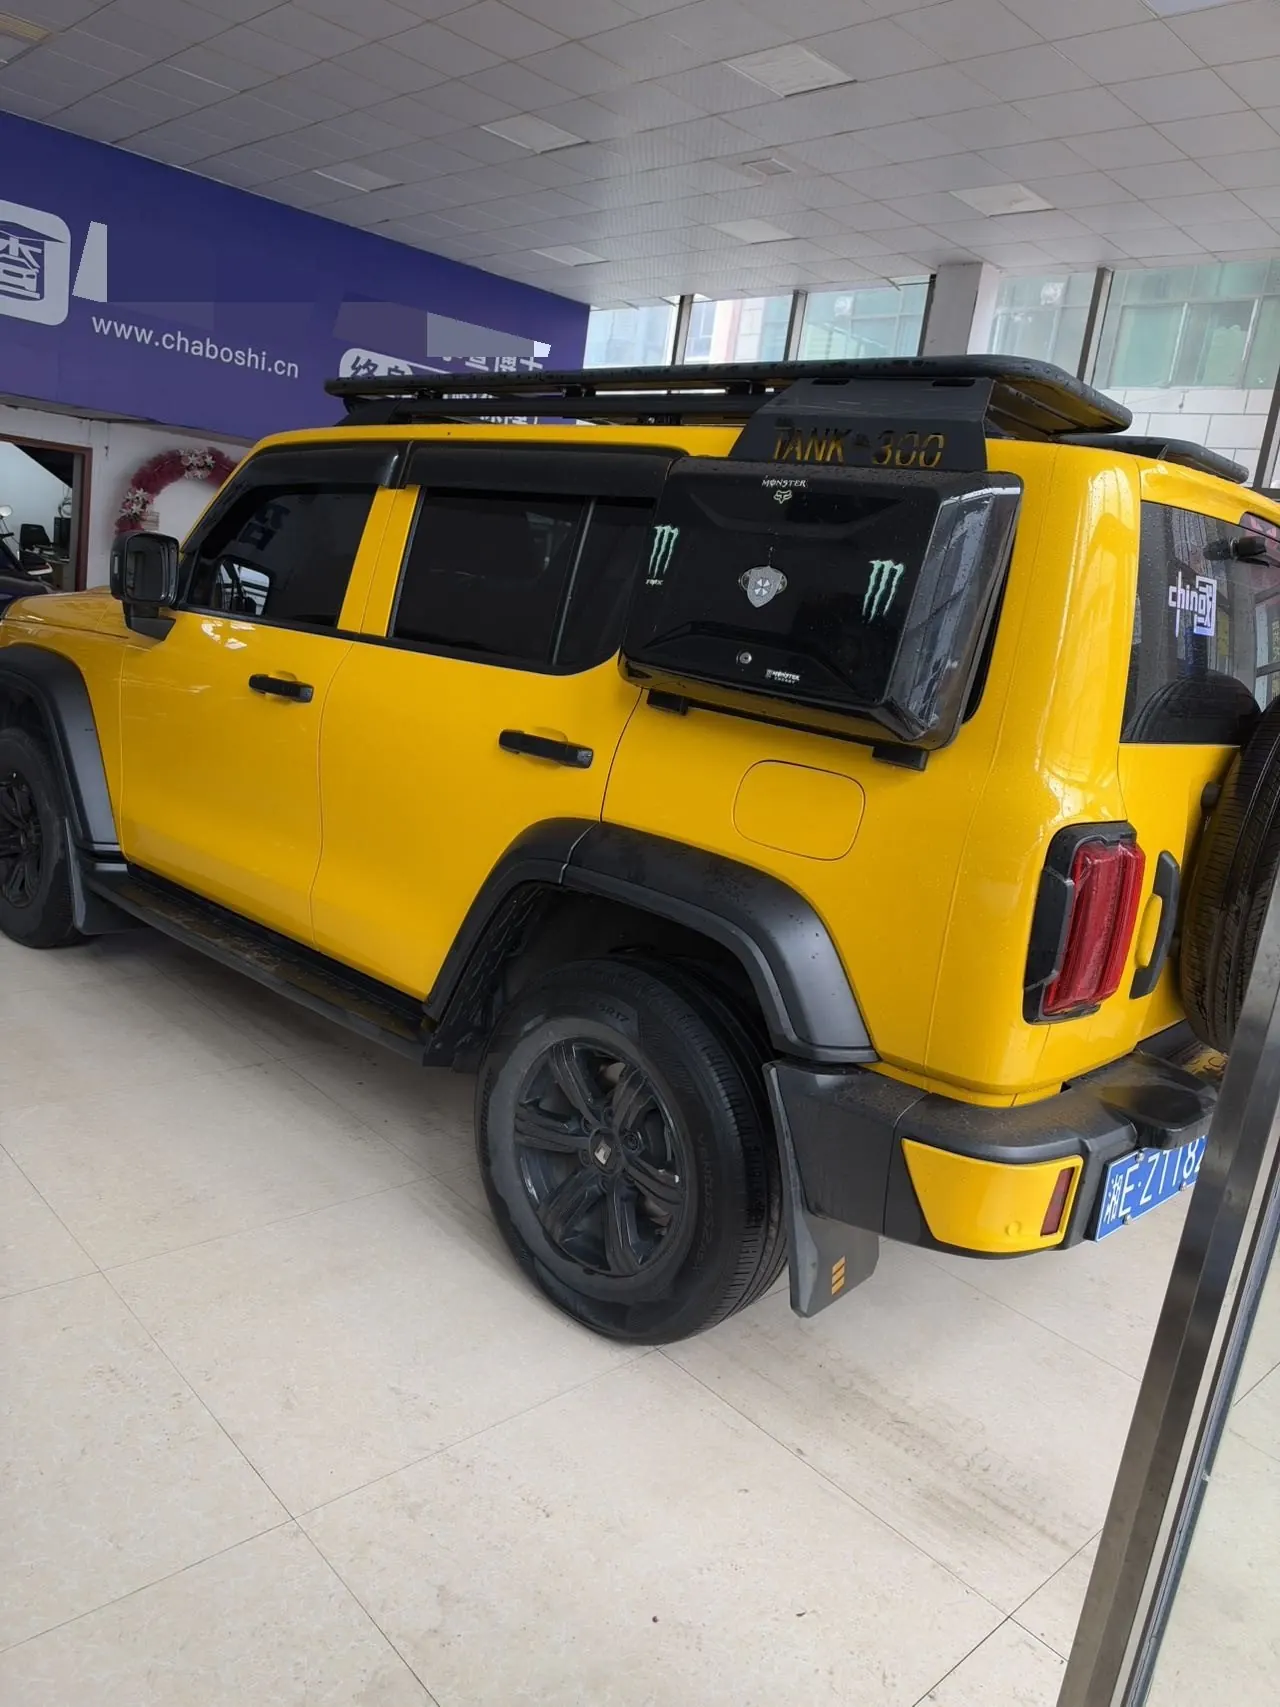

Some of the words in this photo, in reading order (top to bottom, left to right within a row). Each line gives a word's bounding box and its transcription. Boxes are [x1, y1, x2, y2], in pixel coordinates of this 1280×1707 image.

[92, 316, 299, 378] www.chaboshi.cn
[772, 427, 852, 463] TANK
[872, 430, 945, 468] 300
